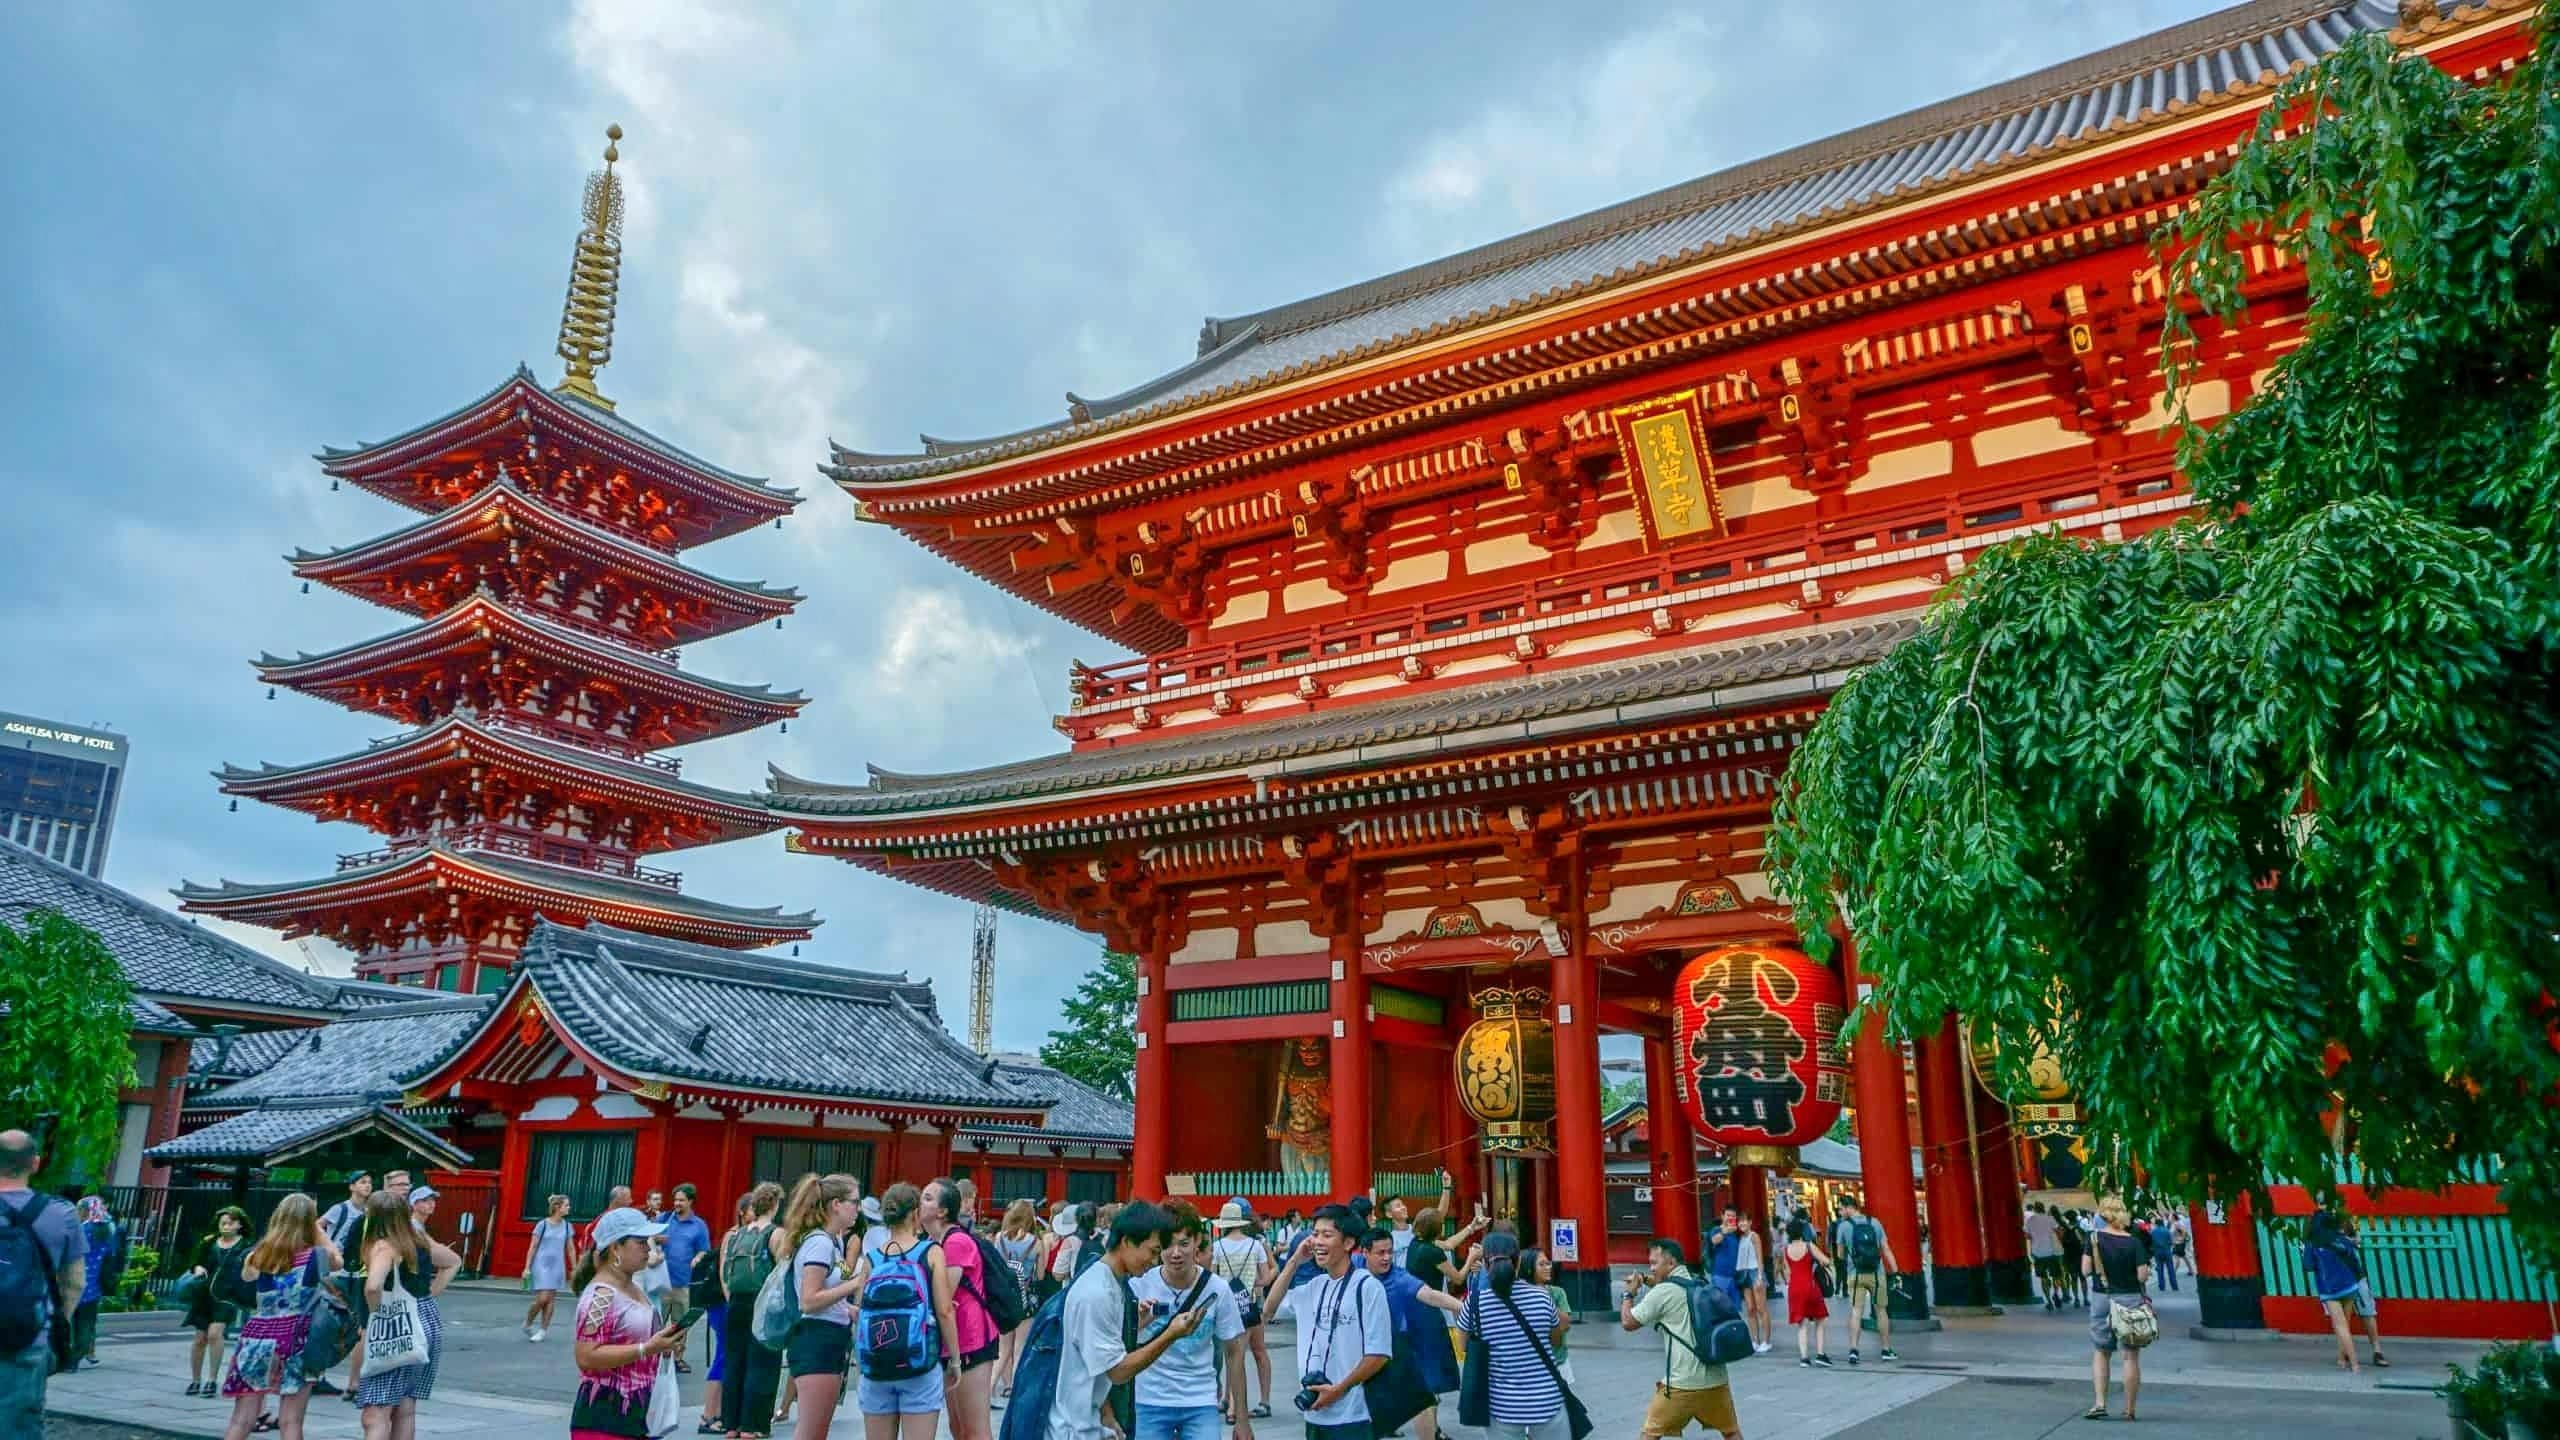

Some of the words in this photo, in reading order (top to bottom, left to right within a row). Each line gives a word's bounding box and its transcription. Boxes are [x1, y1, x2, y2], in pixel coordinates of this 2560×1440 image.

[4, 722, 53, 739] ASAKUSA
[54, 730, 82, 744] VIEW
[84, 736, 116, 751] HOTEL
[369, 1313, 412, 1341] OUTTA
[368, 1336, 413, 1359] SHOPPING
